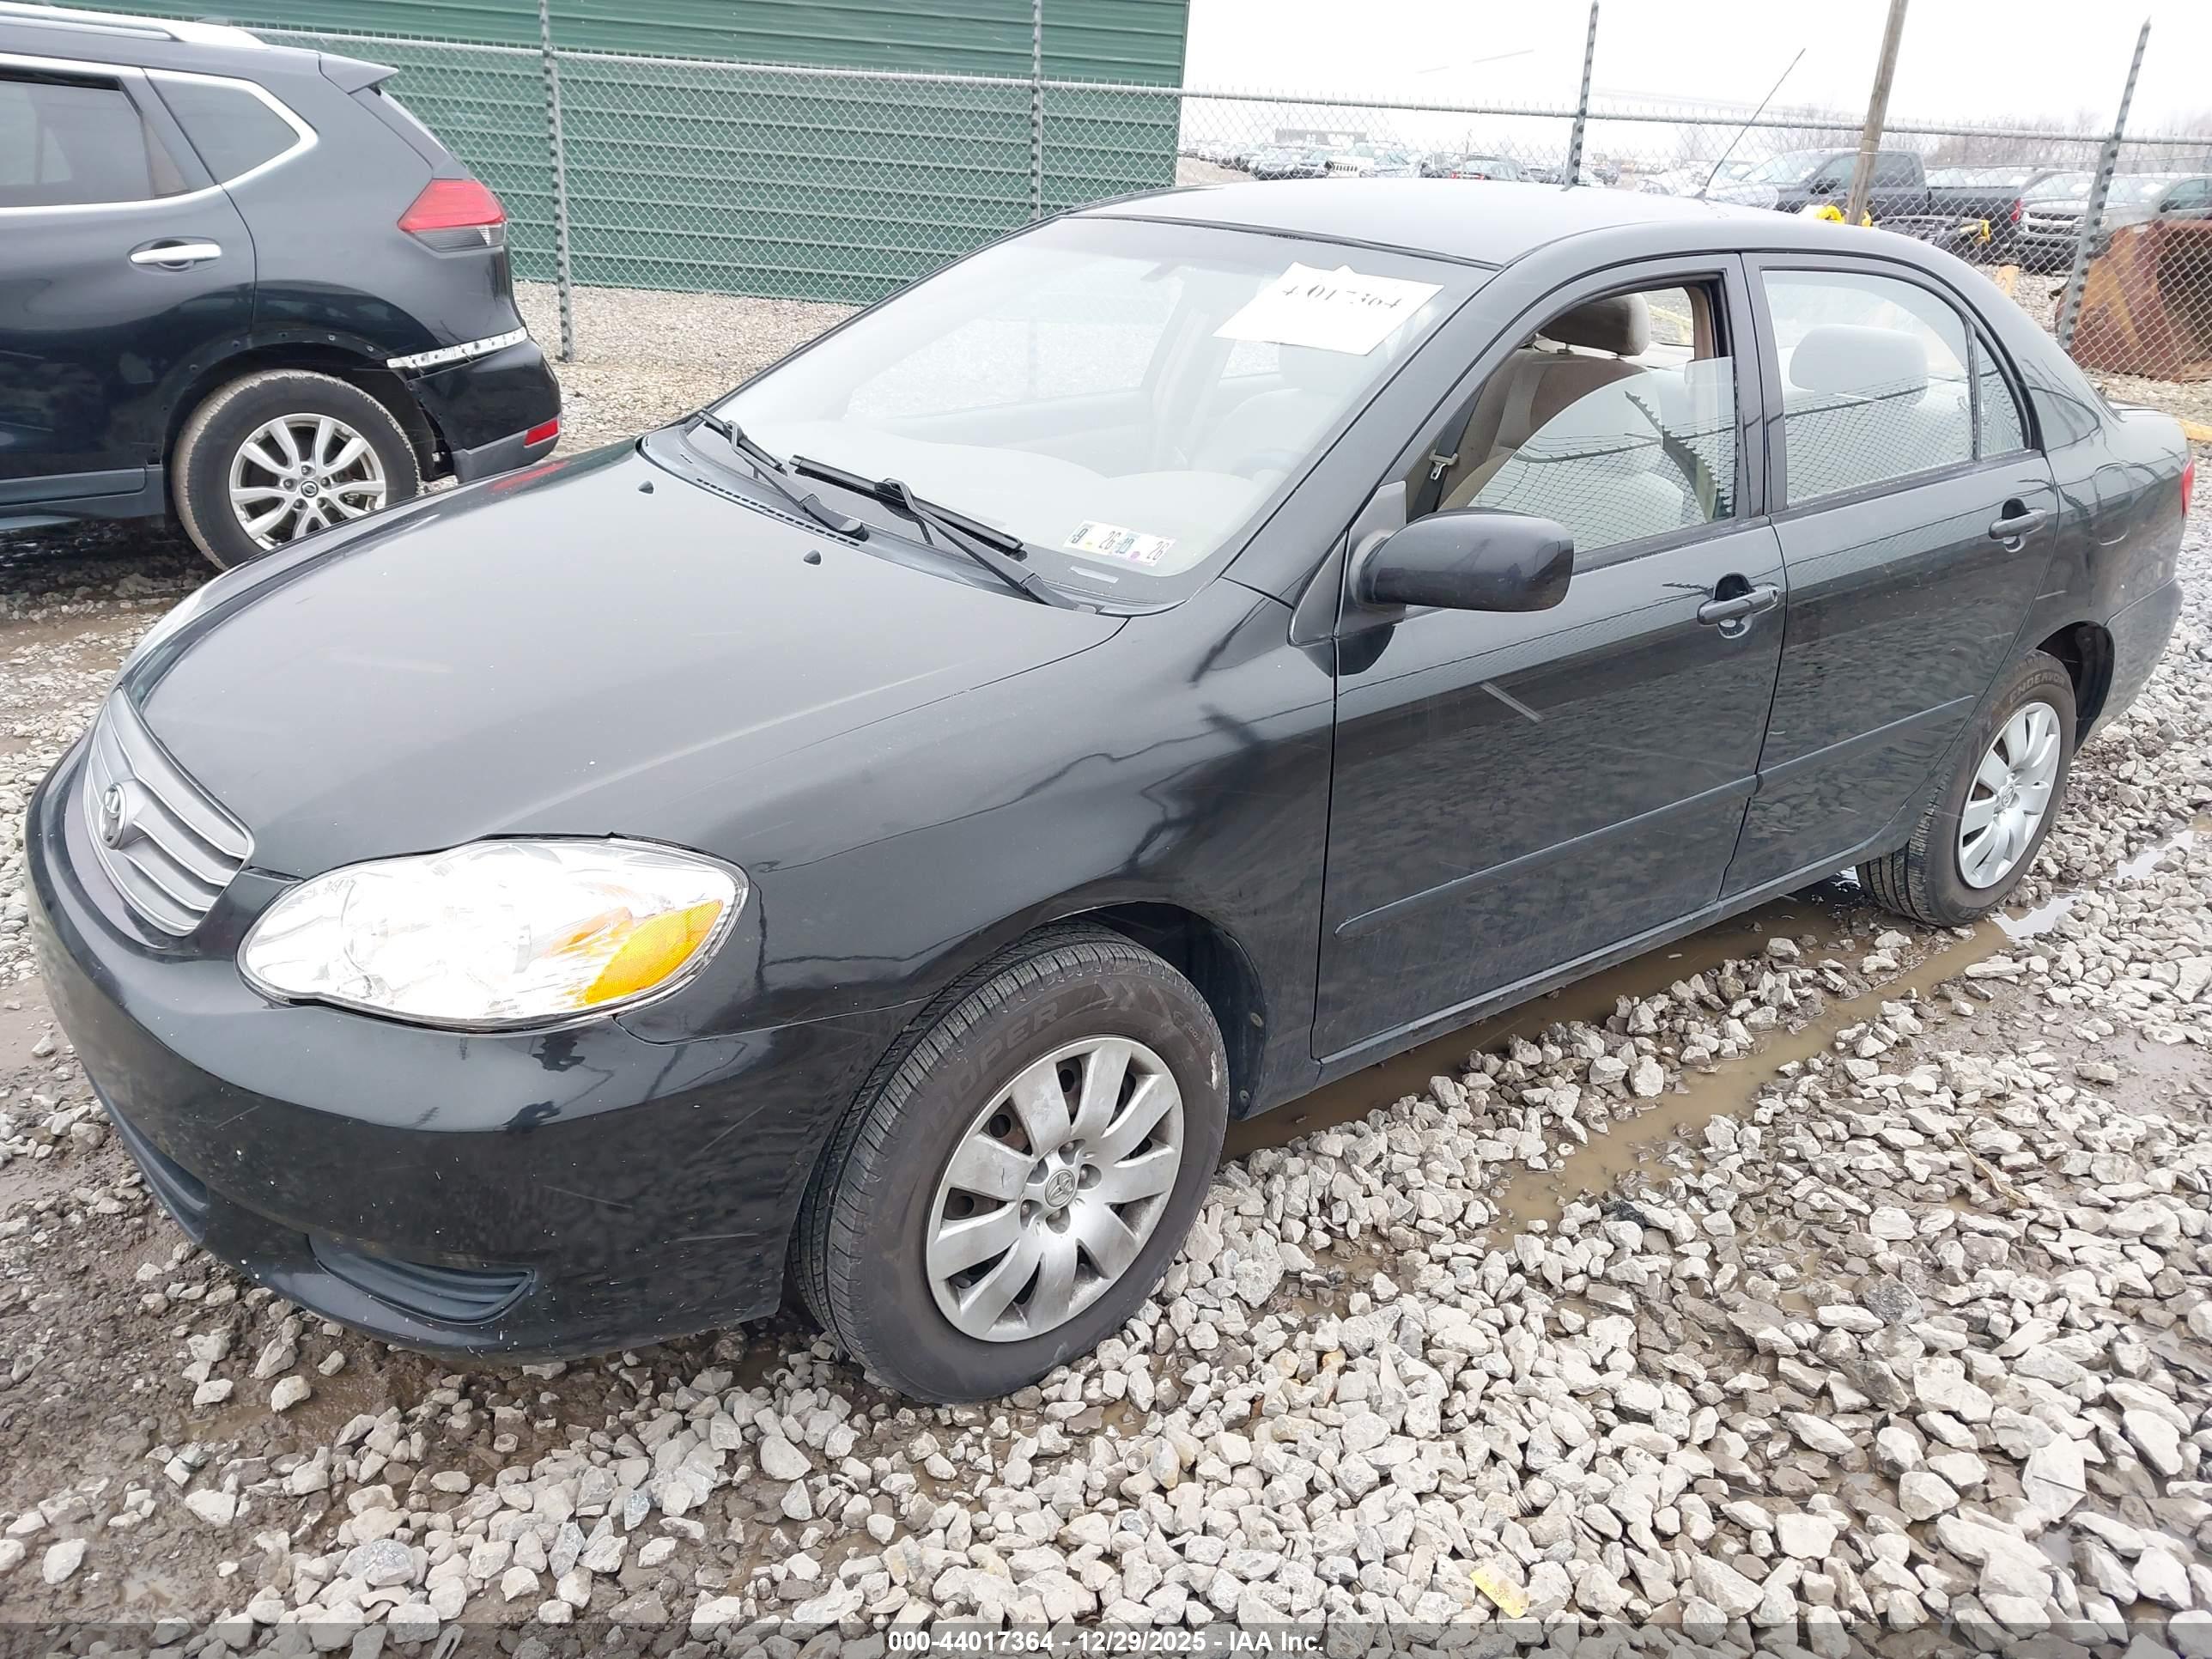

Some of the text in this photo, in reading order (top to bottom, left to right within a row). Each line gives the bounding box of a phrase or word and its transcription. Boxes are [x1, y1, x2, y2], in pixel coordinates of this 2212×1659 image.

[1099, 531, 1121, 550] 26
[1147, 541, 1170, 560] 26
[2009, 673, 2065, 702] ENDEAVOR
